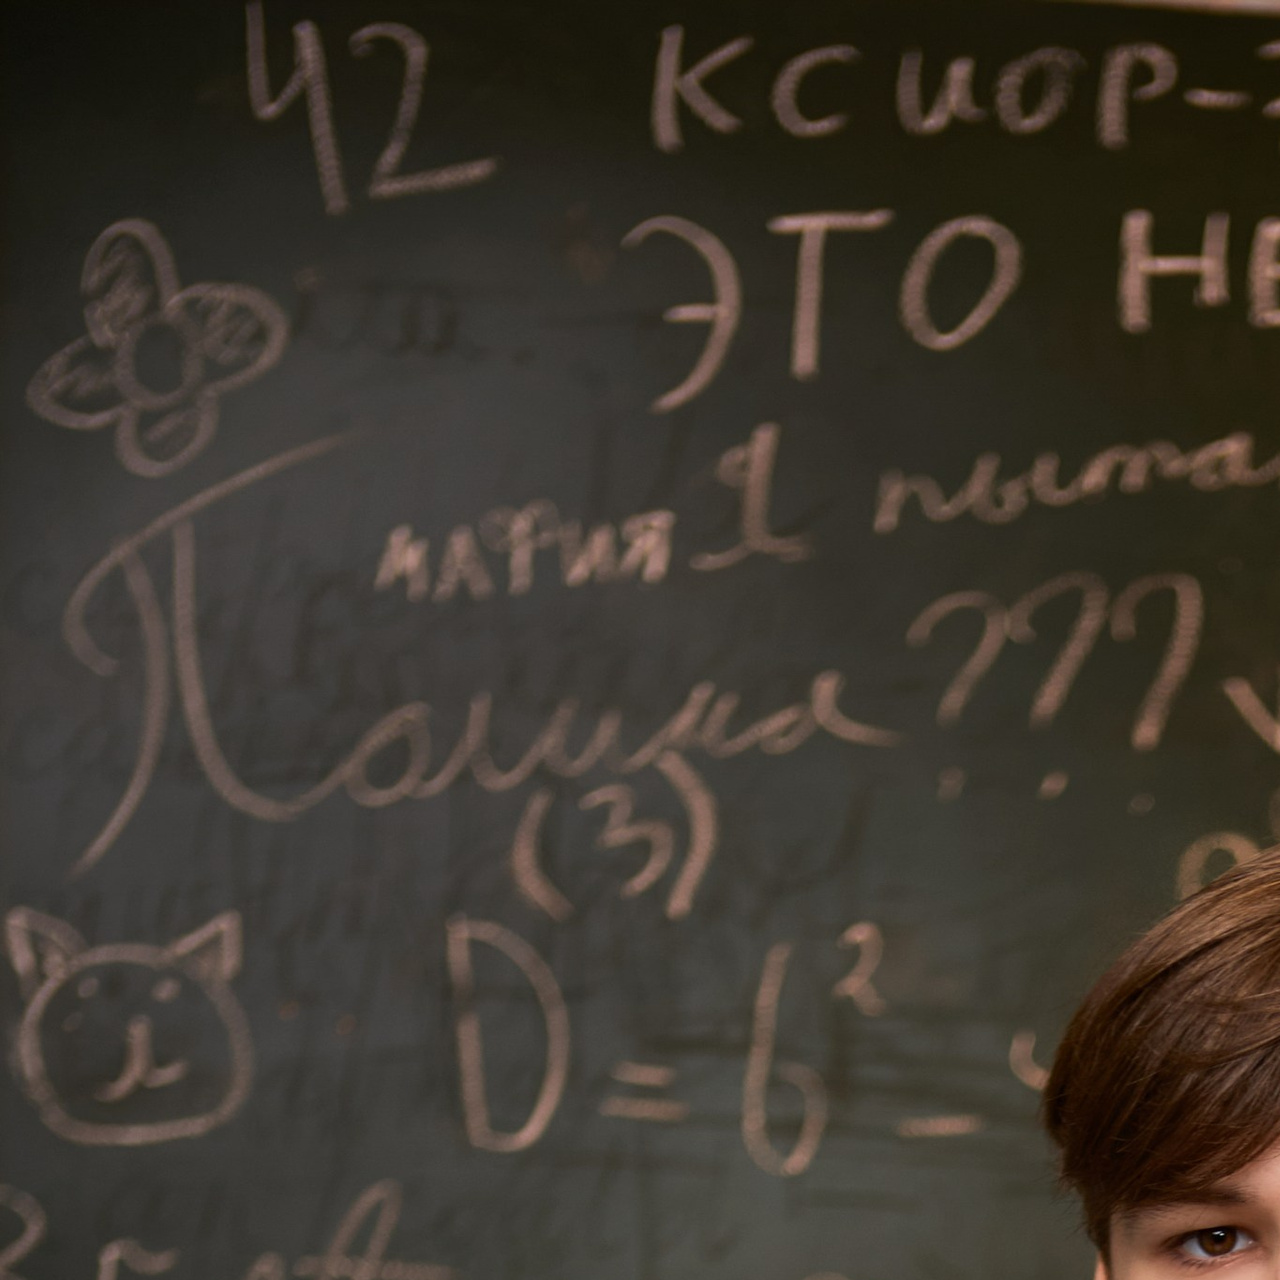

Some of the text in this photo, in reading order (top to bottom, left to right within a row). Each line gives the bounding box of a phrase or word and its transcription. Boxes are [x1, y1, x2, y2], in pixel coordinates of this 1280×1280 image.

[246, 2, 500, 213] 42
[622, 210, 1024, 413] ЭТО
[508, 750, 720, 922] (3)
